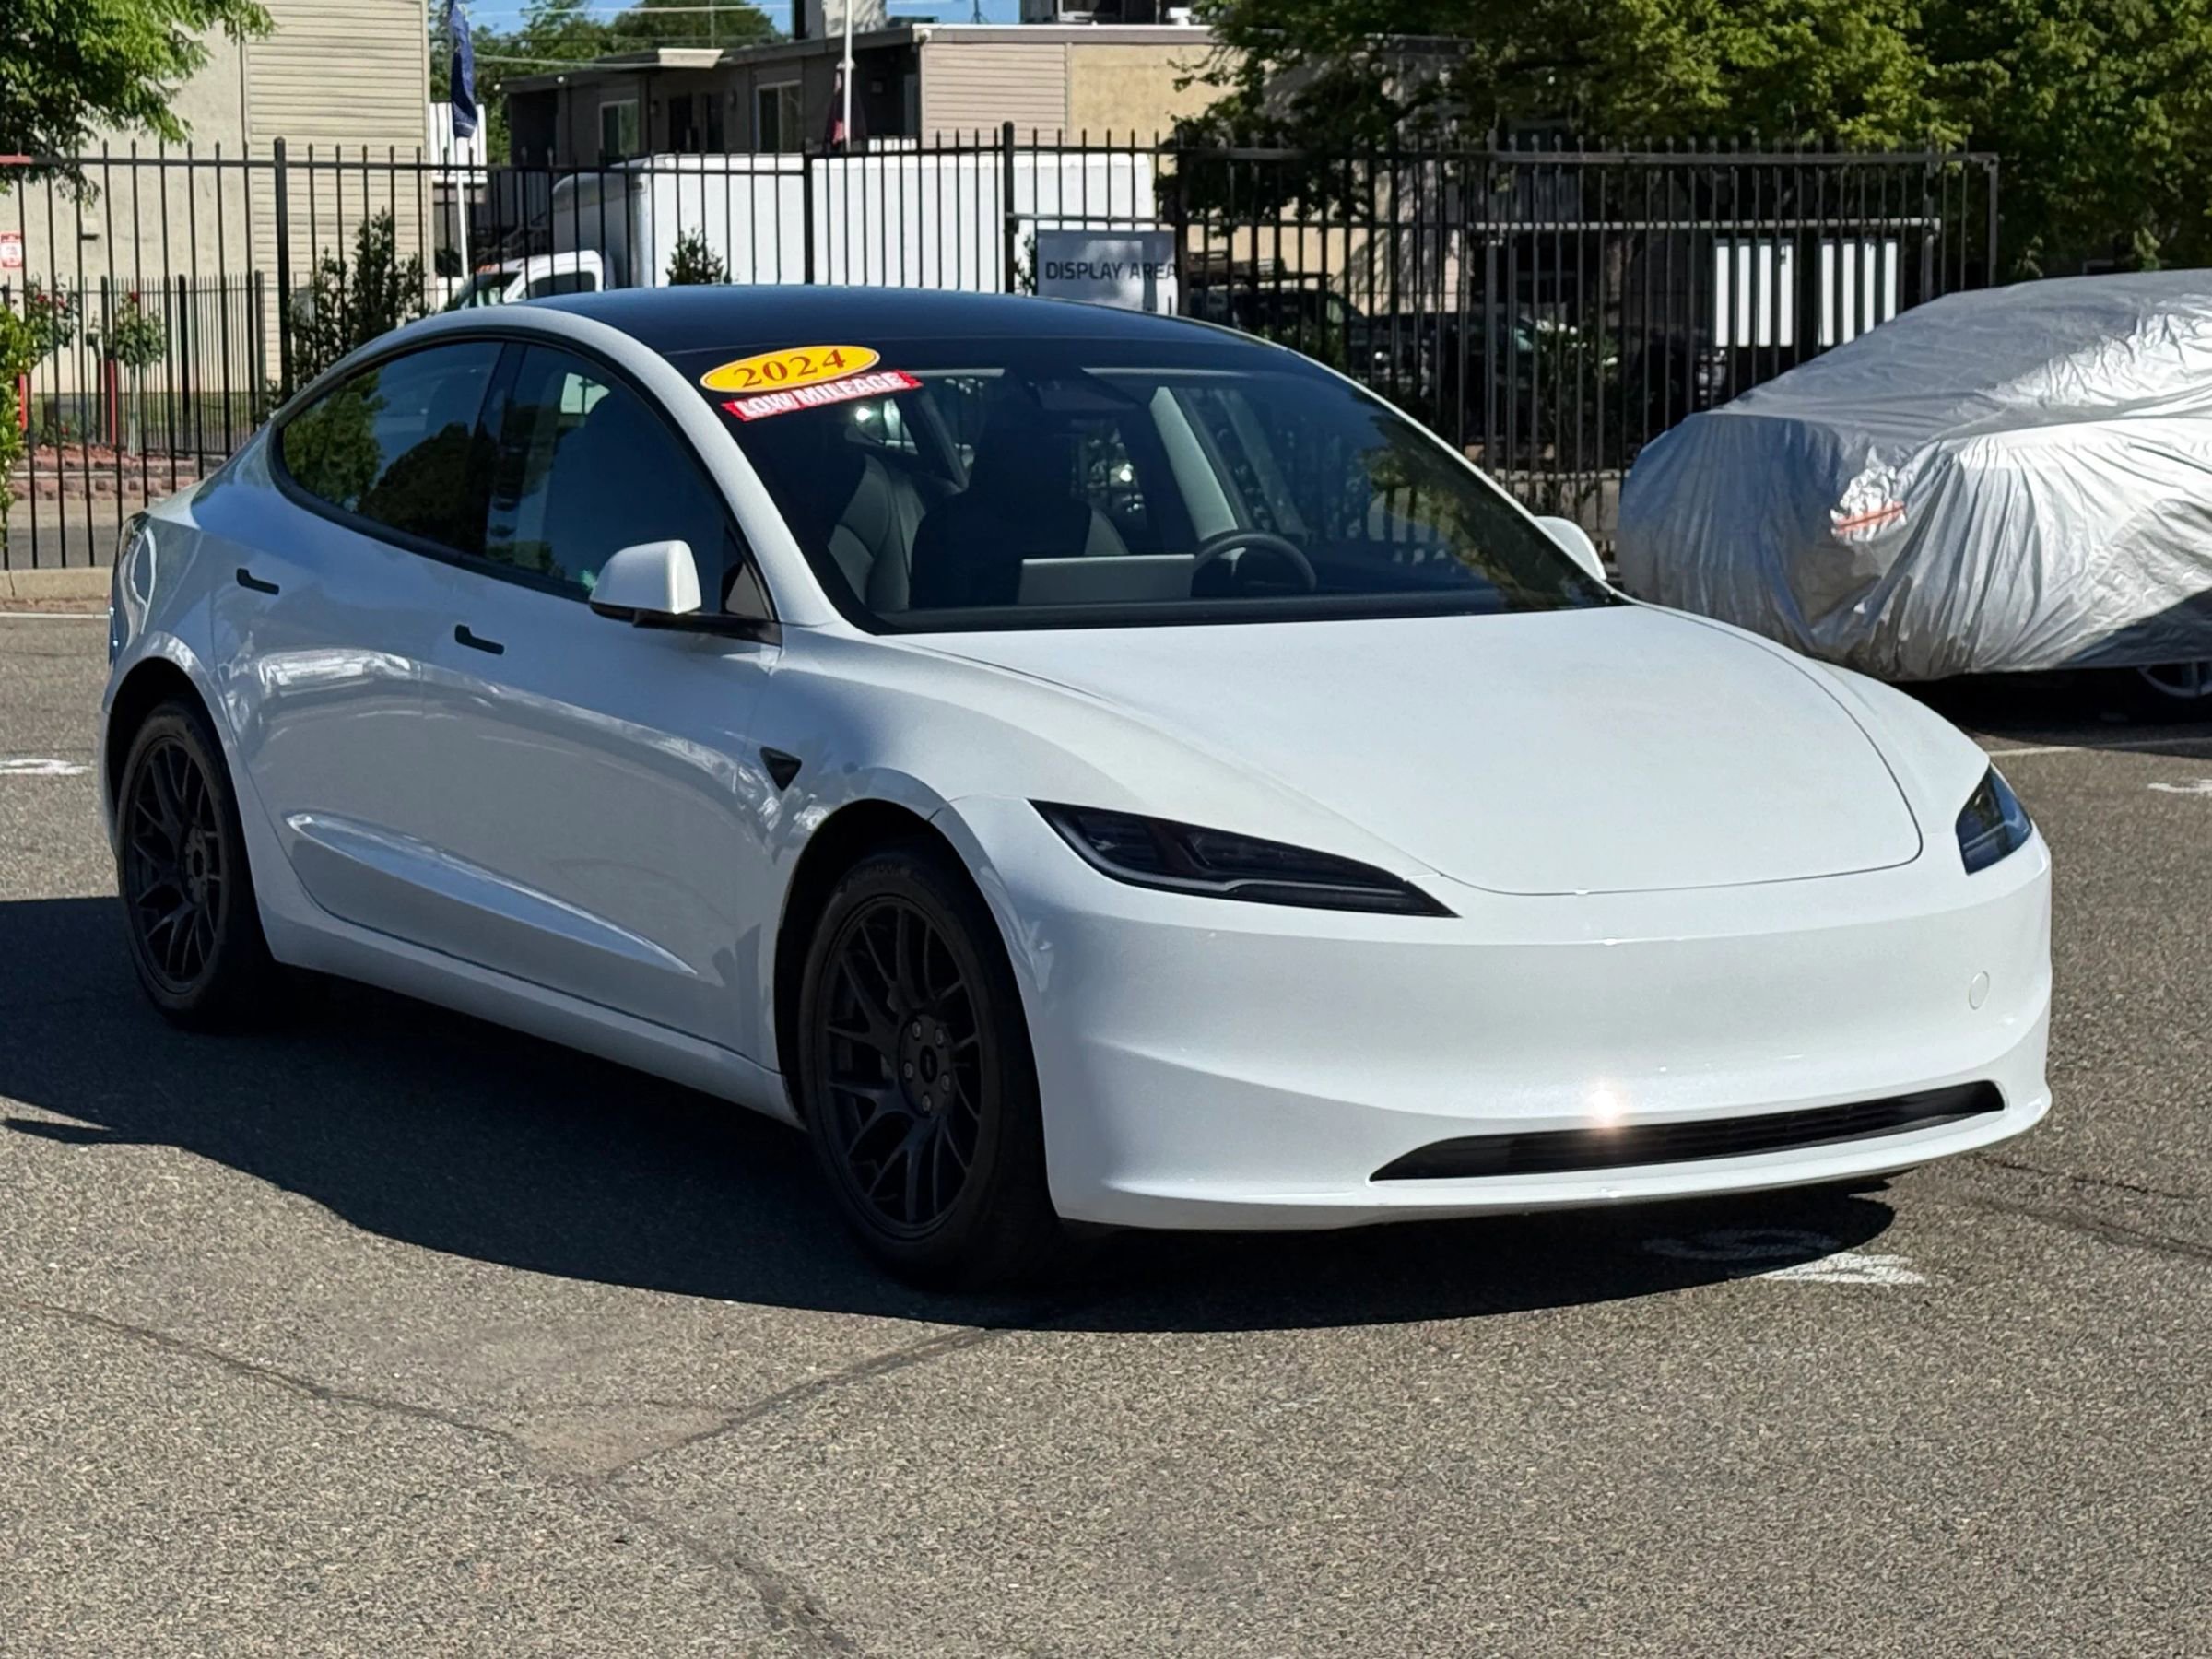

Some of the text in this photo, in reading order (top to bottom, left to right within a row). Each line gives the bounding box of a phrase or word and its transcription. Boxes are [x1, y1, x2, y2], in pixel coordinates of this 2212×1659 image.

[1045, 262, 1178, 280] DISPLAY AREA
[734, 349, 845, 388] 2024
[735, 372, 905, 417] LOW MILEAGE
